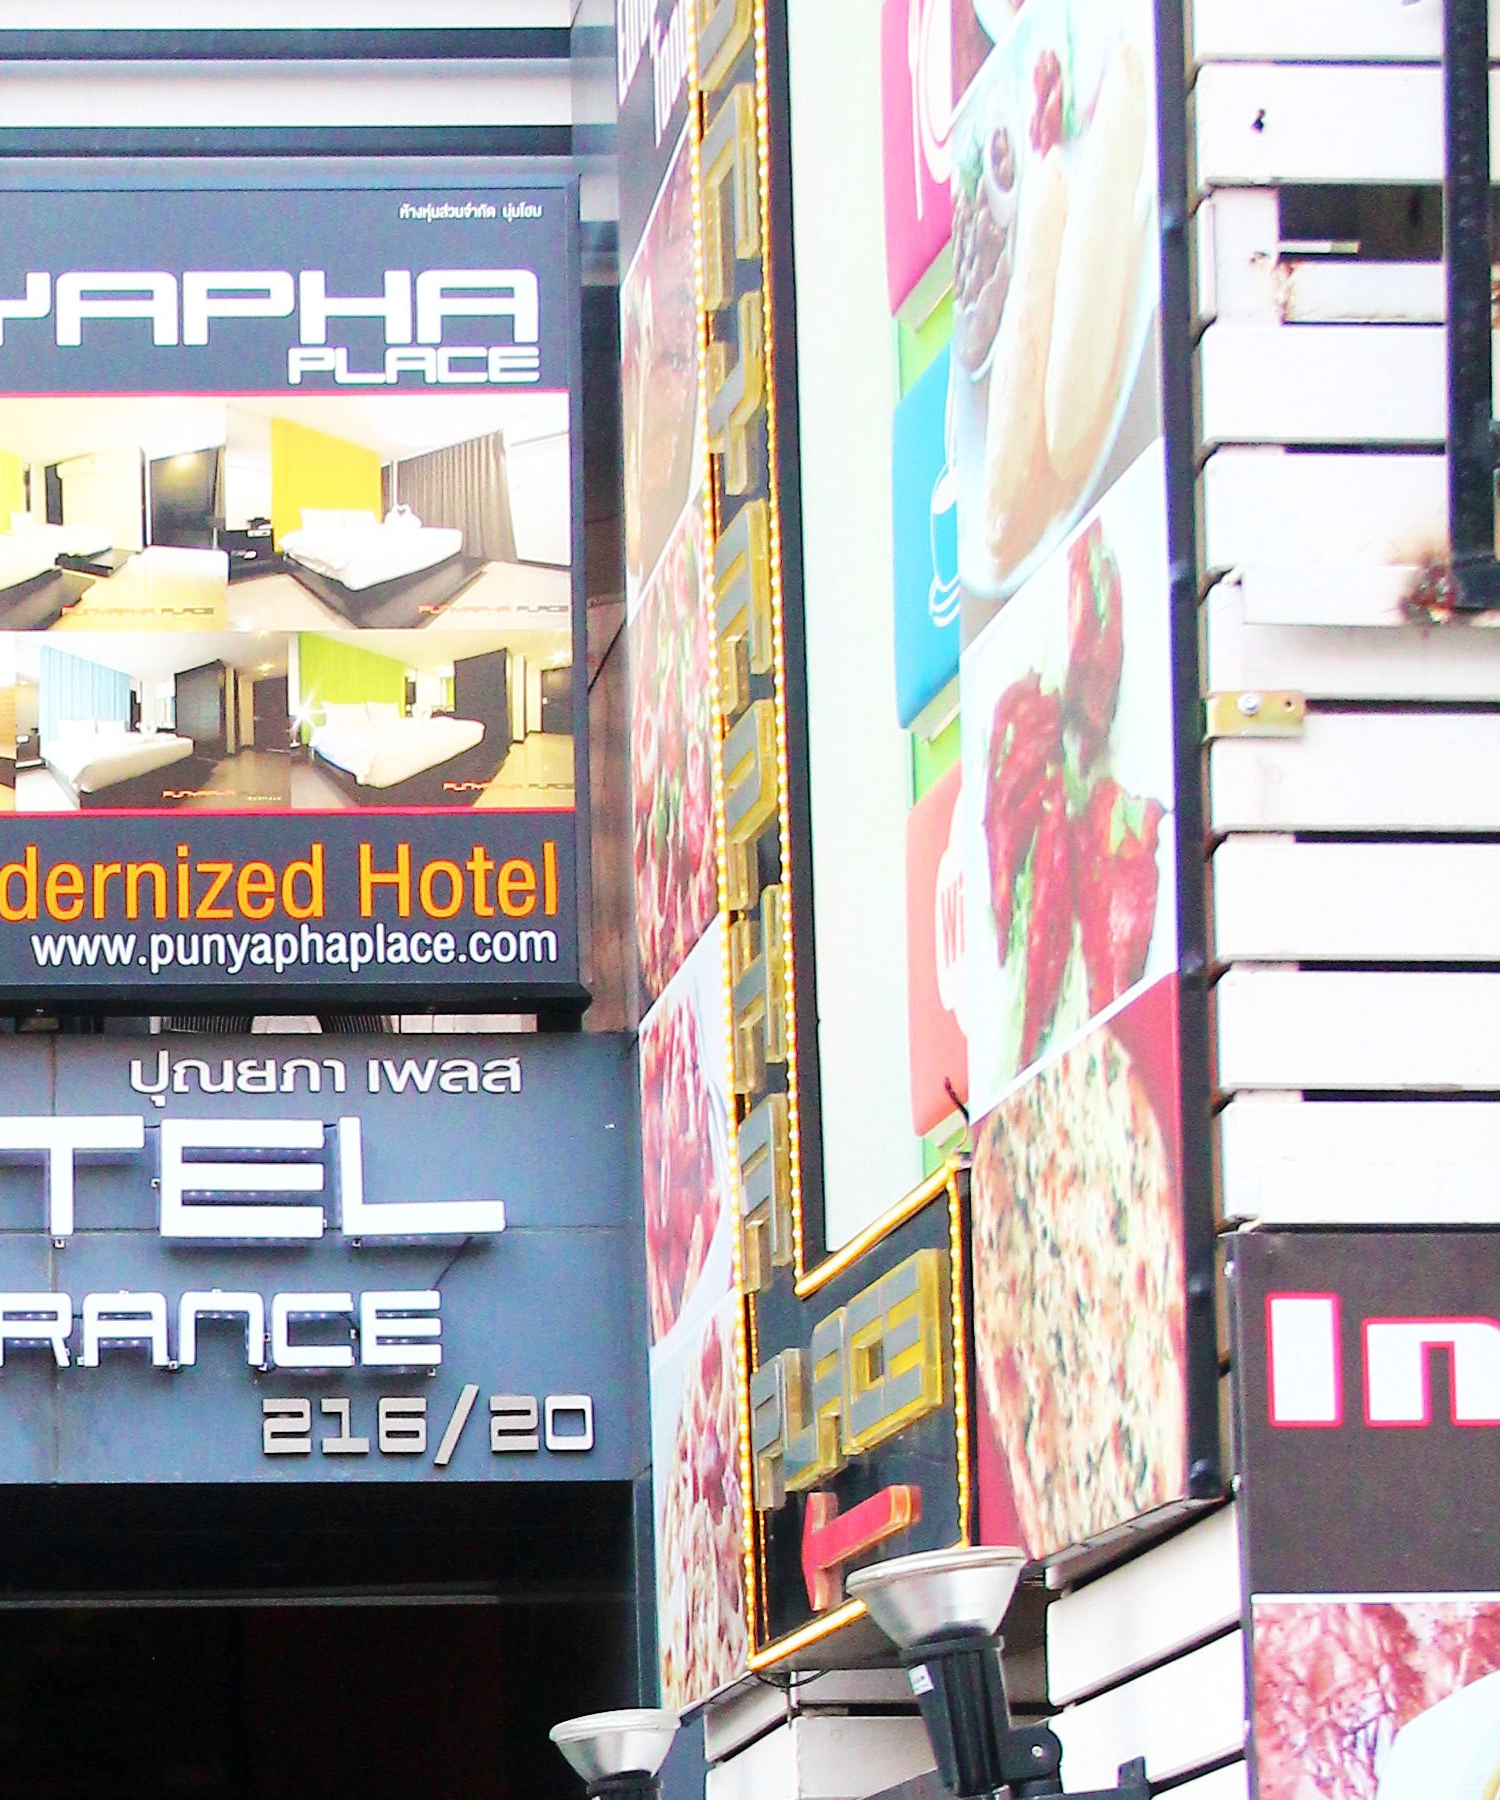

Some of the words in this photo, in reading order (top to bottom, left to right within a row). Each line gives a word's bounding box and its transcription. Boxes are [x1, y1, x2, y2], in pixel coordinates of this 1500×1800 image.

[287, 346, 541, 385] PLACE
[358, 840, 558, 917] Hotel
[31, 924, 558, 975] www.punyaphaplace.com
[129, 1049, 347, 1108] ปุณยภา
[367, 1057, 522, 1094] เพลส
[262, 1383, 594, 1465] 216/20
